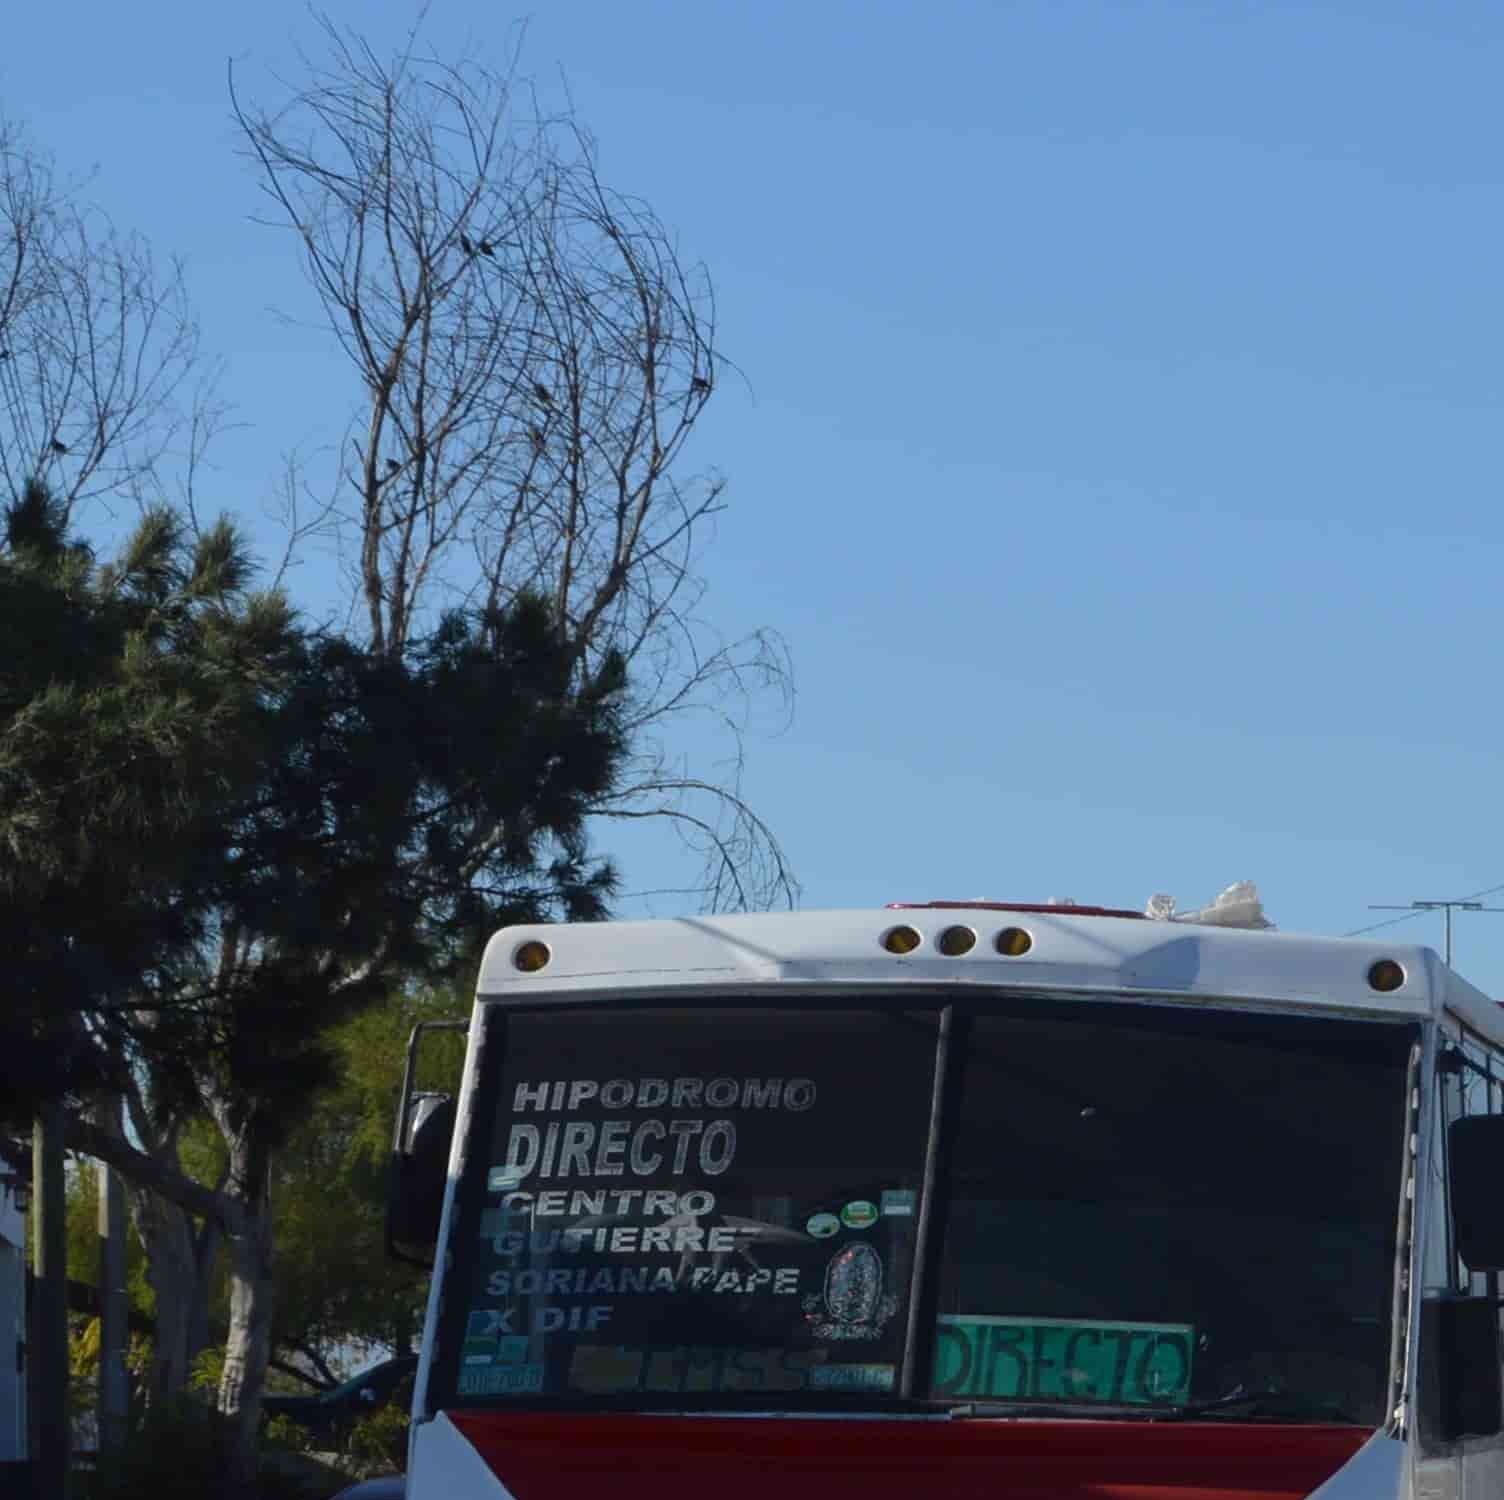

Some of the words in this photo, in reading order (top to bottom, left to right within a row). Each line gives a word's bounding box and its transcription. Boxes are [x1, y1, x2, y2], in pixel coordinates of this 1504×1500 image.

[512, 1078, 817, 1112] HIPODROMO
[504, 1119, 737, 1179] DIRECTO
[502, 1189, 716, 1217] CENTRO
[485, 1266, 678, 1297] SORIANA
[534, 1305, 615, 1332] DIF
